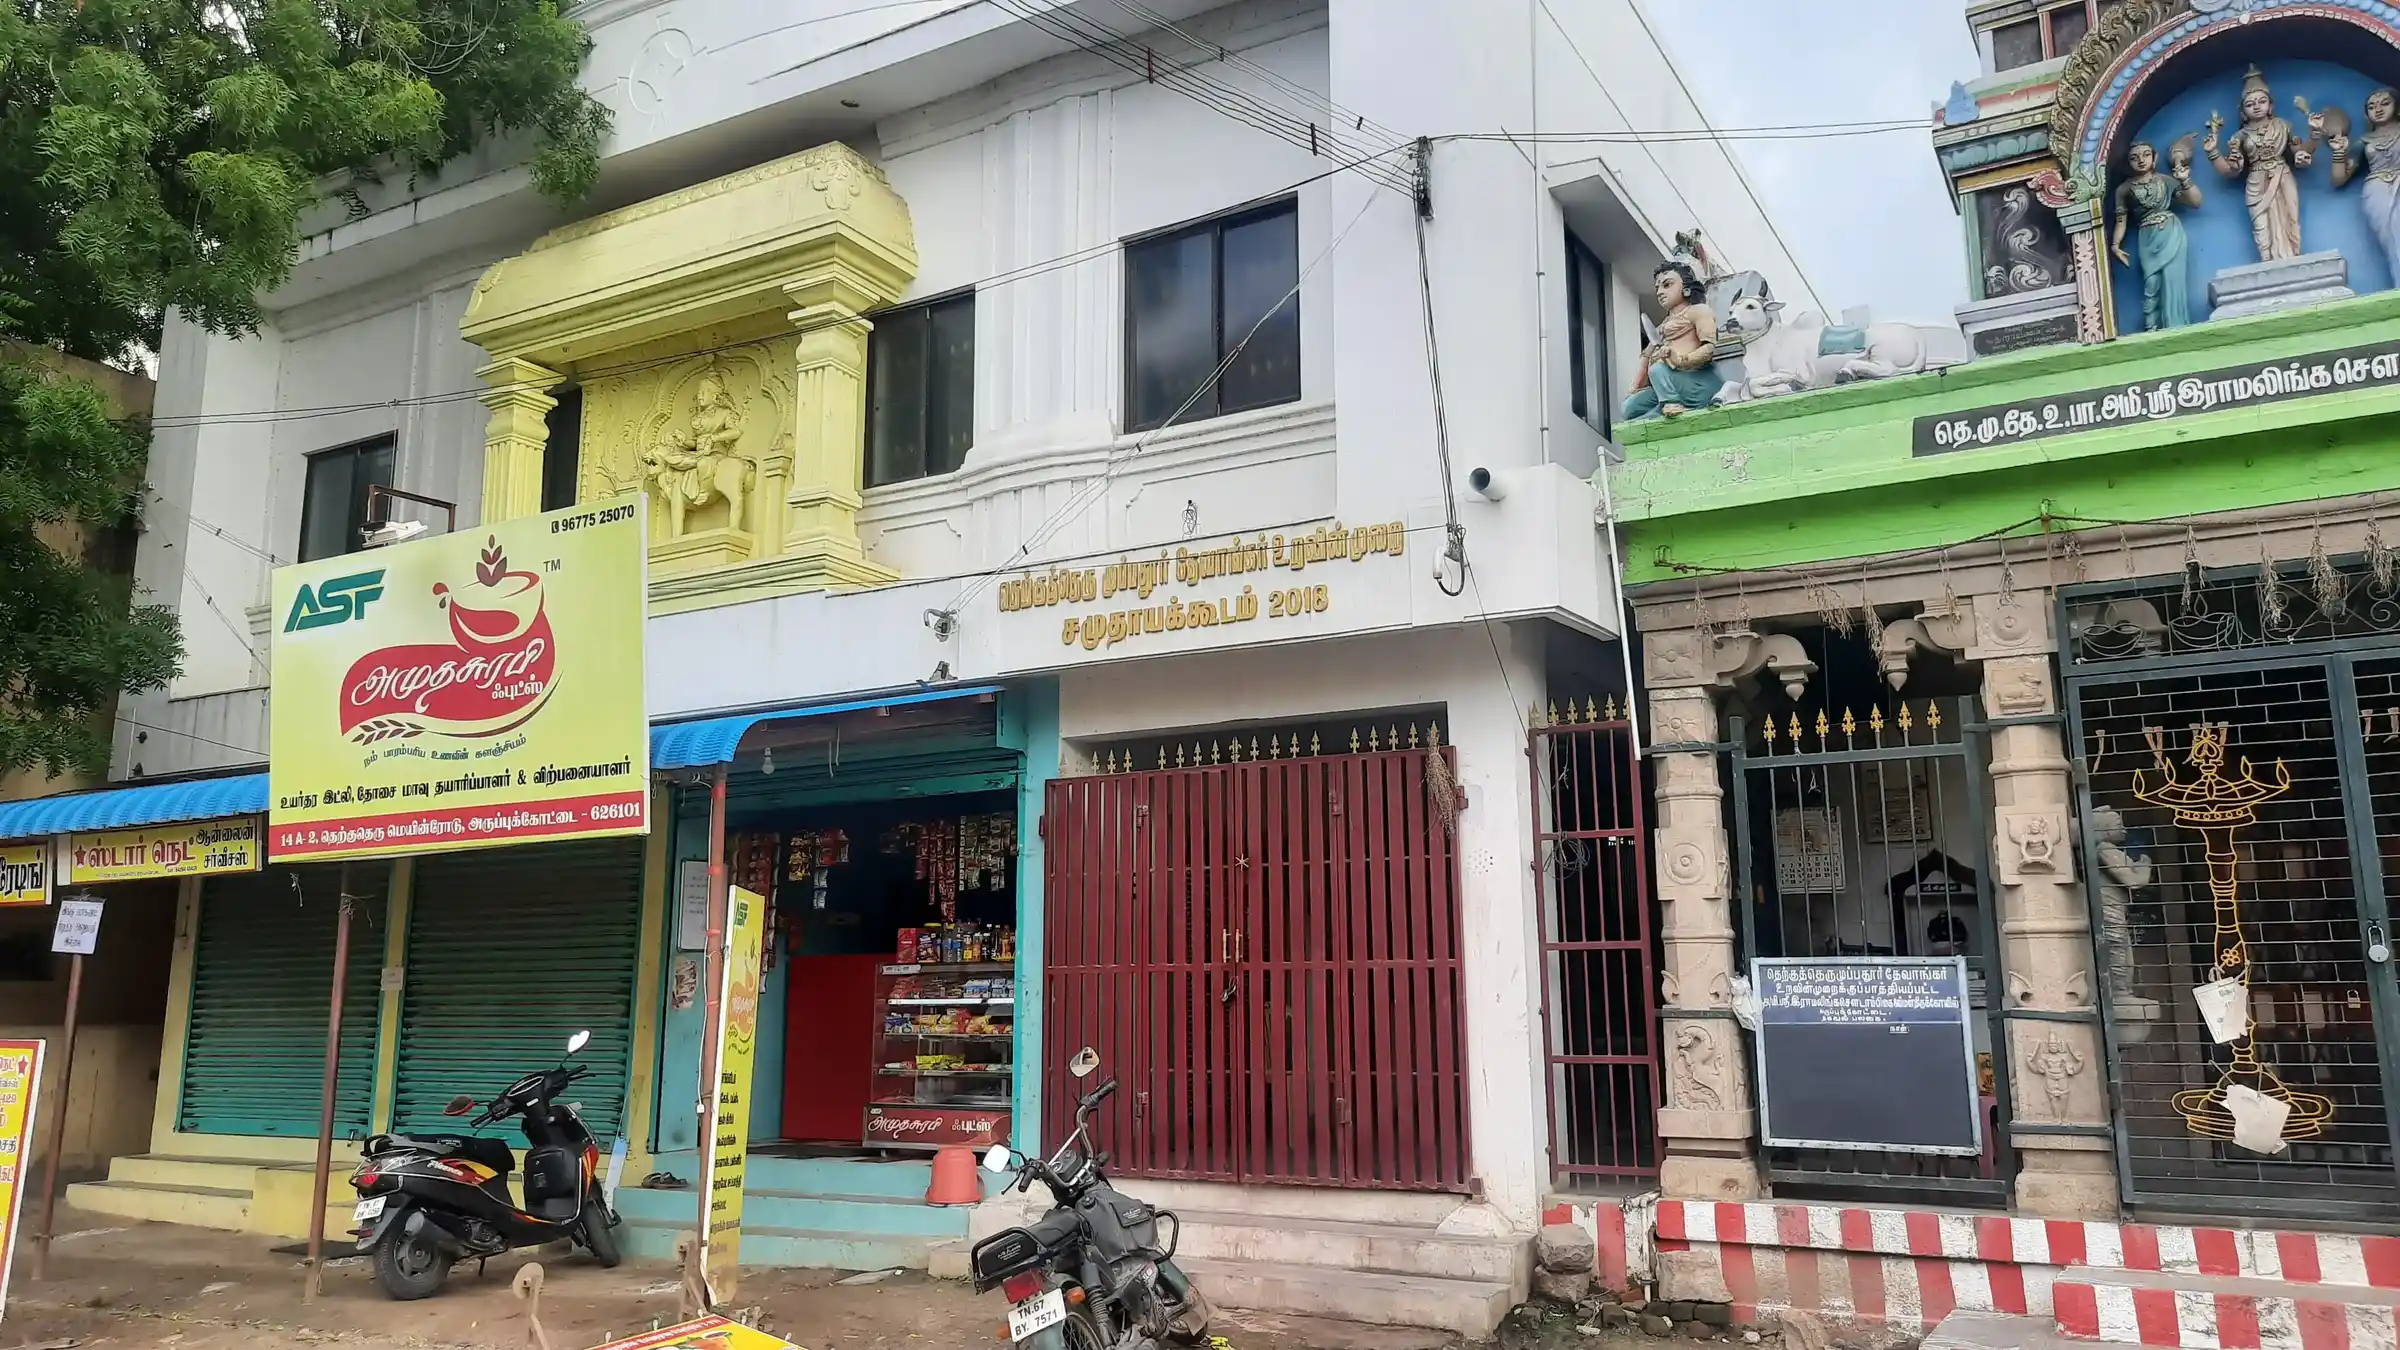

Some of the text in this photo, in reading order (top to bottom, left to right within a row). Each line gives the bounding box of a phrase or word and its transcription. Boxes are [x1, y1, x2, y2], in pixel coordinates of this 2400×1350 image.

[561, 504, 635, 532] 96775 25070
[543, 559, 561, 573] TM
[1175, 532, 1268, 586] தேவாங்கர்
[284, 568, 387, 633] ASF
[1061, 584, 1329, 651] சமுதாயக்கூடம் 2018
[350, 638, 546, 714] அமுதசுரபி
[491, 673, 544, 700] ஃபுட்ஸ்
[363, 733, 527, 769] நம் பாரம்பரிய உணவின் களஞ்சியம்
[280, 755, 631, 810] உயர்தர இட்லி, தோசை மாவு தயாரிப்பாளர் & விற்பனையாளர்
[196, 820, 254, 846] ஆன்லைன்
[281, 834, 293, 847] 14
[321, 826, 385, 846] தெற்குதெரு
[387, 818, 466, 836] மெயின்ரோடு,
[468, 810, 578, 833] அருப்புக்கோட்டை
[590, 802, 641, 821] 626101
[88, 835, 197, 870] ஸ்டார் நெட்
[204, 845, 249, 869] சர்வீசஸ்
[1885, 966, 1948, 983] தேவாங்கர்
[868, 1116, 992, 1139] அமுதசுரபி ஃபுட்ஸ்
[1017, 1299, 1045, 1320] TN.67
[1034, 1308, 1058, 1328] 7571
